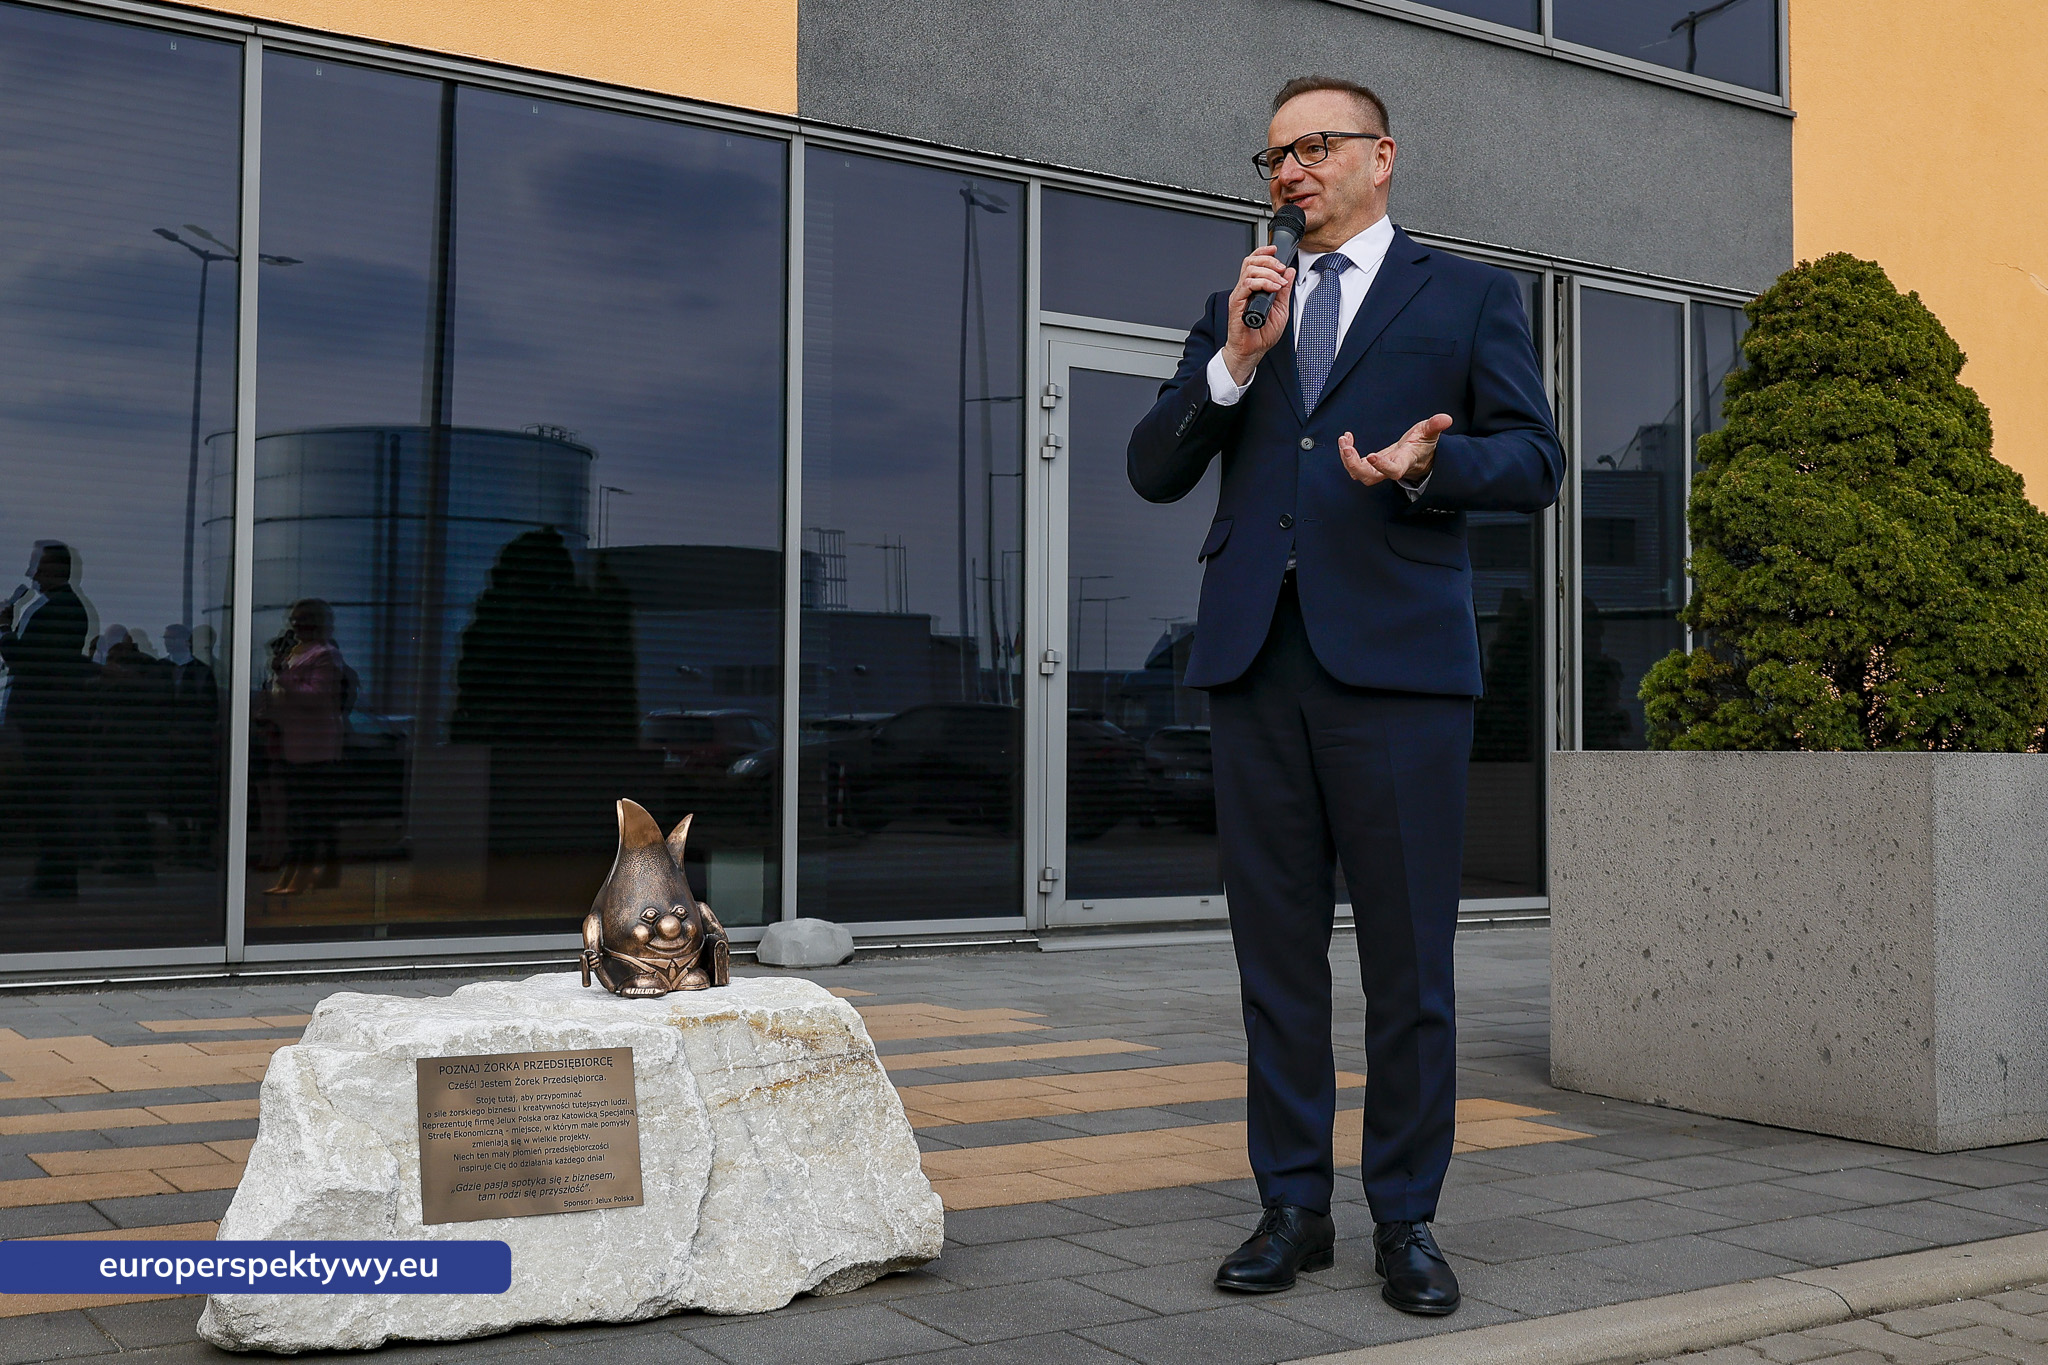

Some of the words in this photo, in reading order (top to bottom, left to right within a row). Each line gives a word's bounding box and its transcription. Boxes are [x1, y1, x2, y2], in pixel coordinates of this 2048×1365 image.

[439, 1064, 480, 1075] POZNAJ
[484, 1061, 520, 1073] ŻORKA
[523, 1056, 613, 1070] PRZEDSIĘBIORCĘ
[448, 1080, 477, 1090] Cześć!
[480, 1079, 511, 1088] Jestem
[515, 1076, 540, 1086] Żorek
[543, 1074, 607, 1085] Przedsiębiorca.
[476, 1096, 496, 1104] Stoję
[498, 1094, 518, 1103] tutaj,
[520, 1094, 534, 1102] aby
[536, 1090, 582, 1101] przypominać
[434, 1110, 447, 1118] sile
[449, 1109, 485, 1117] żorskiego
[523, 1102, 570, 1112] kreatywności
[572, 1099, 608, 1109] tutejszych
[422, 1120, 472, 1130] Reprezentuję
[474, 1118, 495, 1126] firmę
[497, 1117, 516, 1125] Jelux
[518, 1115, 541, 1123] Polska
[561, 1111, 598, 1119] Katowicką
[599, 1109, 635, 1118] Specjalną
[427, 1132, 451, 1140] Strefę
[454, 1127, 503, 1138] Ekonomiczną
[511, 1125, 542, 1134] miejsce,
[552, 1122, 578, 1131] którym
[600, 1118, 630, 1128] pomysły
[472, 1138, 509, 1148] zmieniają
[511, 1137, 521, 1145] się
[531, 1135, 557, 1143] wielkie
[559, 1133, 591, 1142] projekty.
[453, 1152, 474, 1161] Niech
[491, 1150, 510, 1158] mały
[512, 1146, 542, 1158] płomień
[544, 1142, 609, 1155] przedsiębiorczości
[459, 1163, 492, 1172] inspiruje
[494, 1162, 506, 1170] Cię
[520, 1158, 553, 1168] działania
[554, 1156, 585, 1165] każdego
[483, 1180, 508, 1191] pasja
[511, 1176, 546, 1188] spotyka
[549, 1176, 562, 1185] się
[564, 1175, 569, 1183] z
[572, 1171, 616, 1182] biznesem,
[478, 1193, 496, 1202] tam
[499, 1190, 521, 1200] rodzi
[523, 1189, 537, 1198] się
[563, 1199, 593, 1208] Sponsor:
[595, 1197, 613, 1205] Jelux
[614, 1195, 635, 1203] Polska
